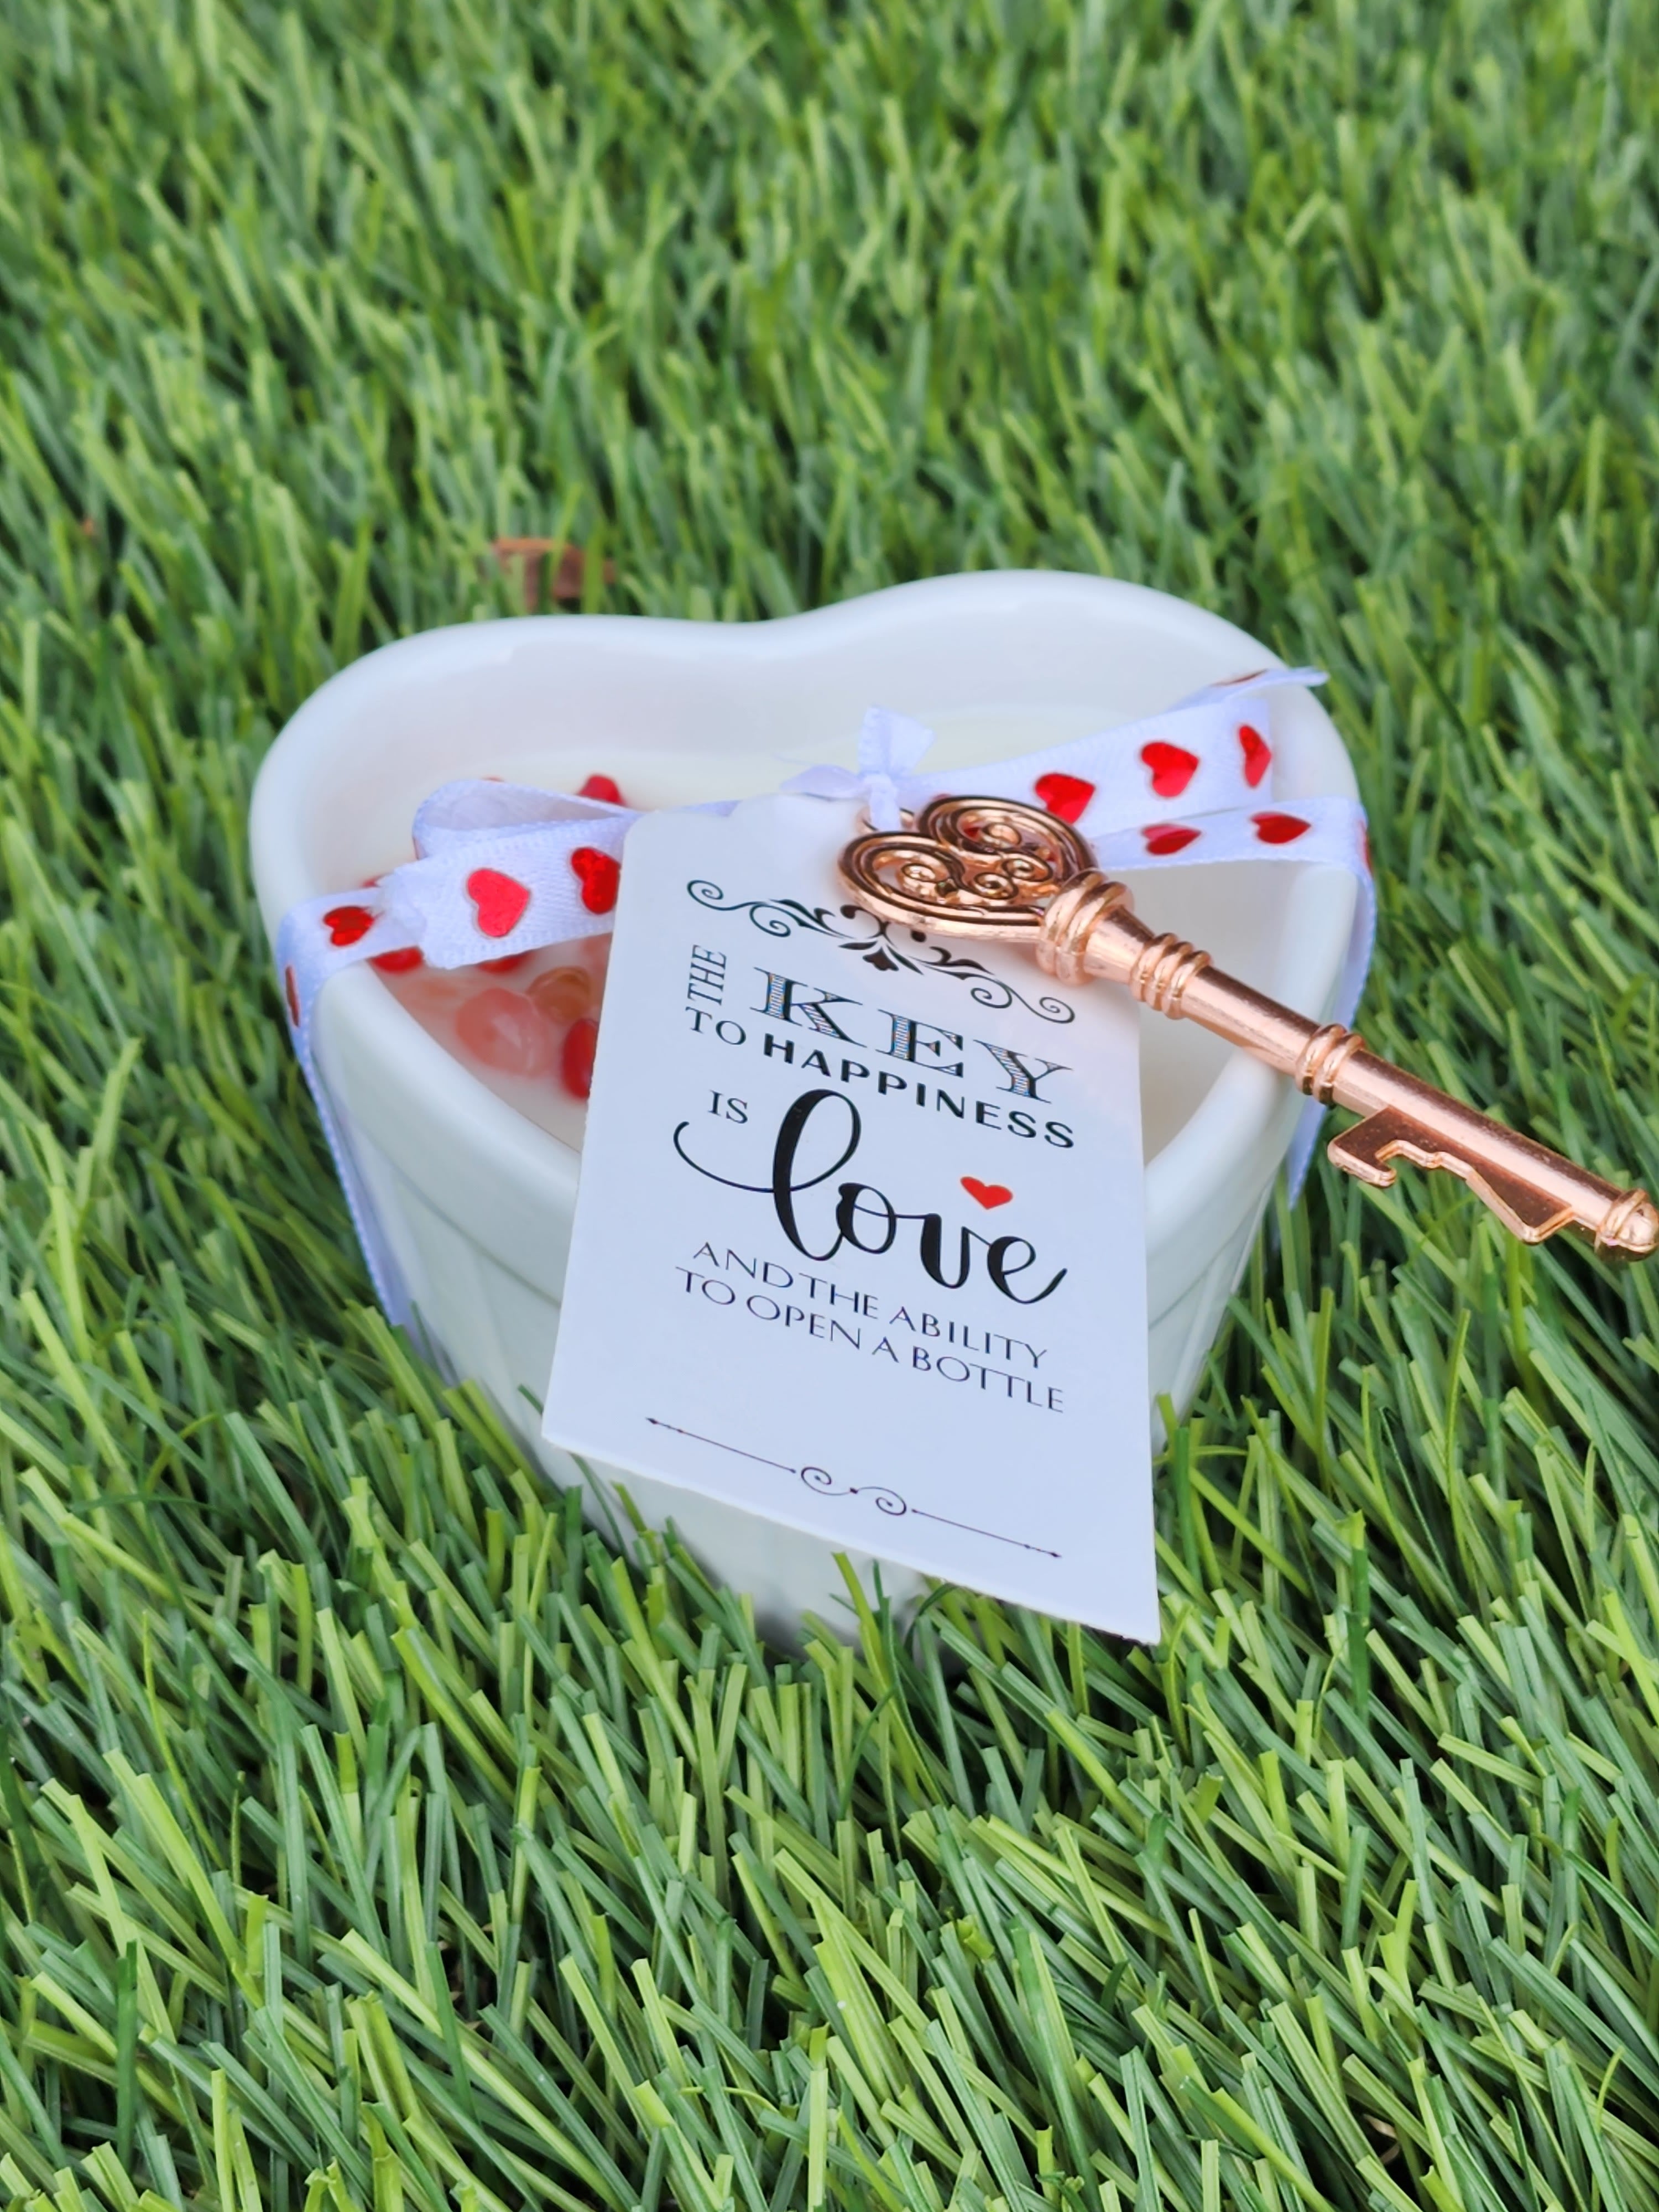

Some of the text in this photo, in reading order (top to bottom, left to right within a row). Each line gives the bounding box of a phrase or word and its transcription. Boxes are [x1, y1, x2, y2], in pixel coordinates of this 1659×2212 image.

[687, 945, 727, 1006] THE
[749, 966, 1074, 1103] KEY
[685, 1006, 1074, 1148] TO HAPPINESS
[708, 1089, 748, 1124] IS
[673, 1088, 1068, 1304] love
[675, 1266, 1065, 1413] TO OPEN A BOTTLE
[693, 1241, 1048, 1369] AND THE ABILITY
